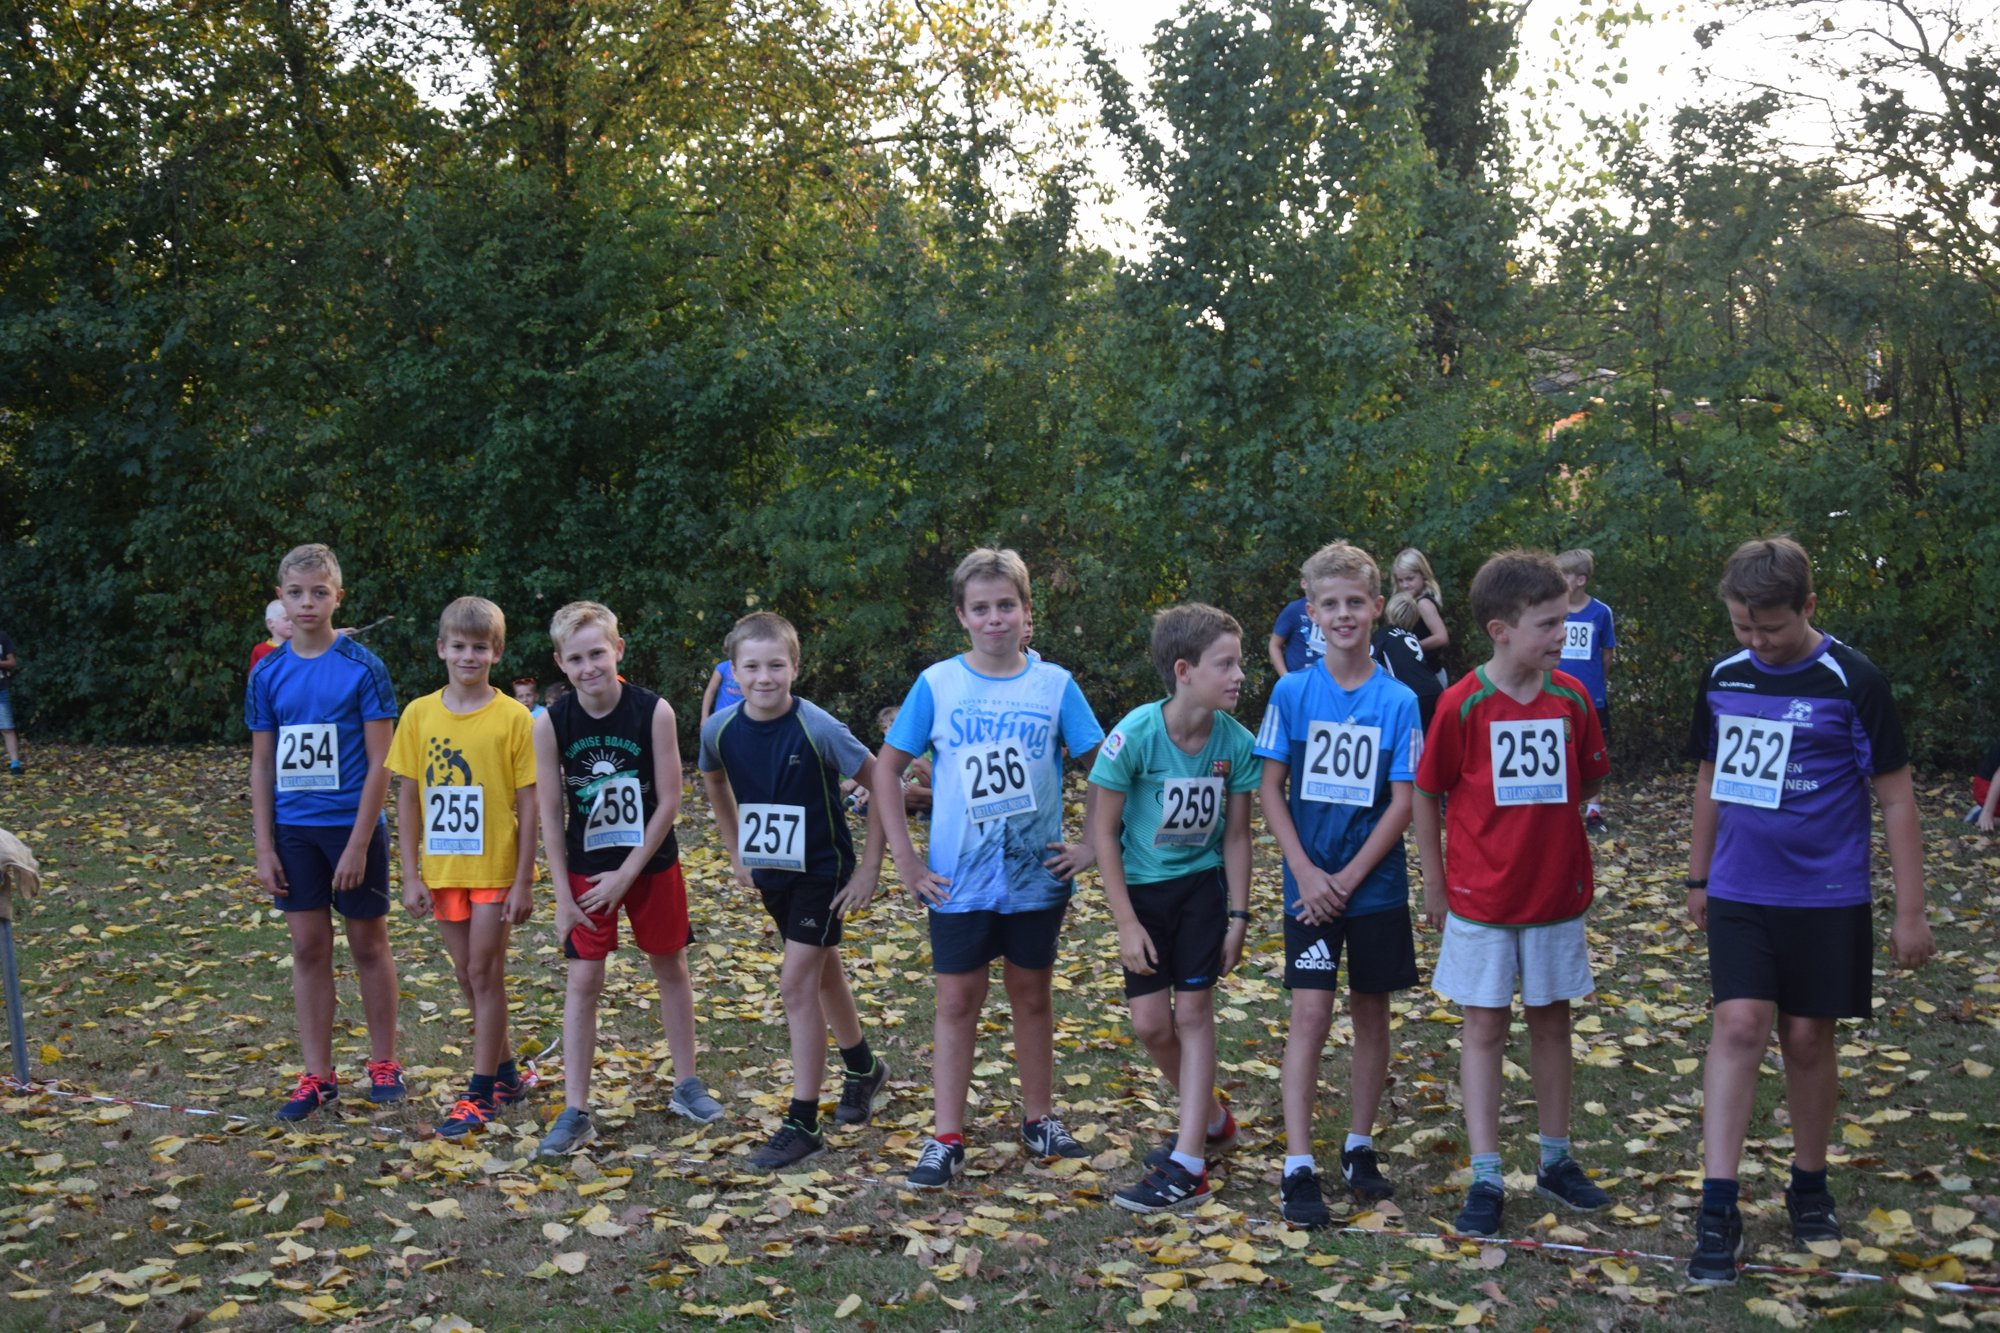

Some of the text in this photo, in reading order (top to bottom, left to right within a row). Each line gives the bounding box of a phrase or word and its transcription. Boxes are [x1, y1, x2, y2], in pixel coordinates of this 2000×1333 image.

[1404, 636, 1424, 662] 9
[282, 731, 334, 770] 254
[604, 735, 642, 757] BOARDS
[949, 708, 1052, 760] Surfing
[1310, 729, 1372, 780] 260
[1497, 728, 1560, 778] 253
[1720, 725, 1784, 781] 252
[965, 747, 1025, 800] 256
[431, 793, 479, 833] 255
[589, 785, 638, 831] 258
[1163, 785, 1215, 829] 259
[744, 812, 800, 855] 257
[1295, 957, 1336, 970] adidas
